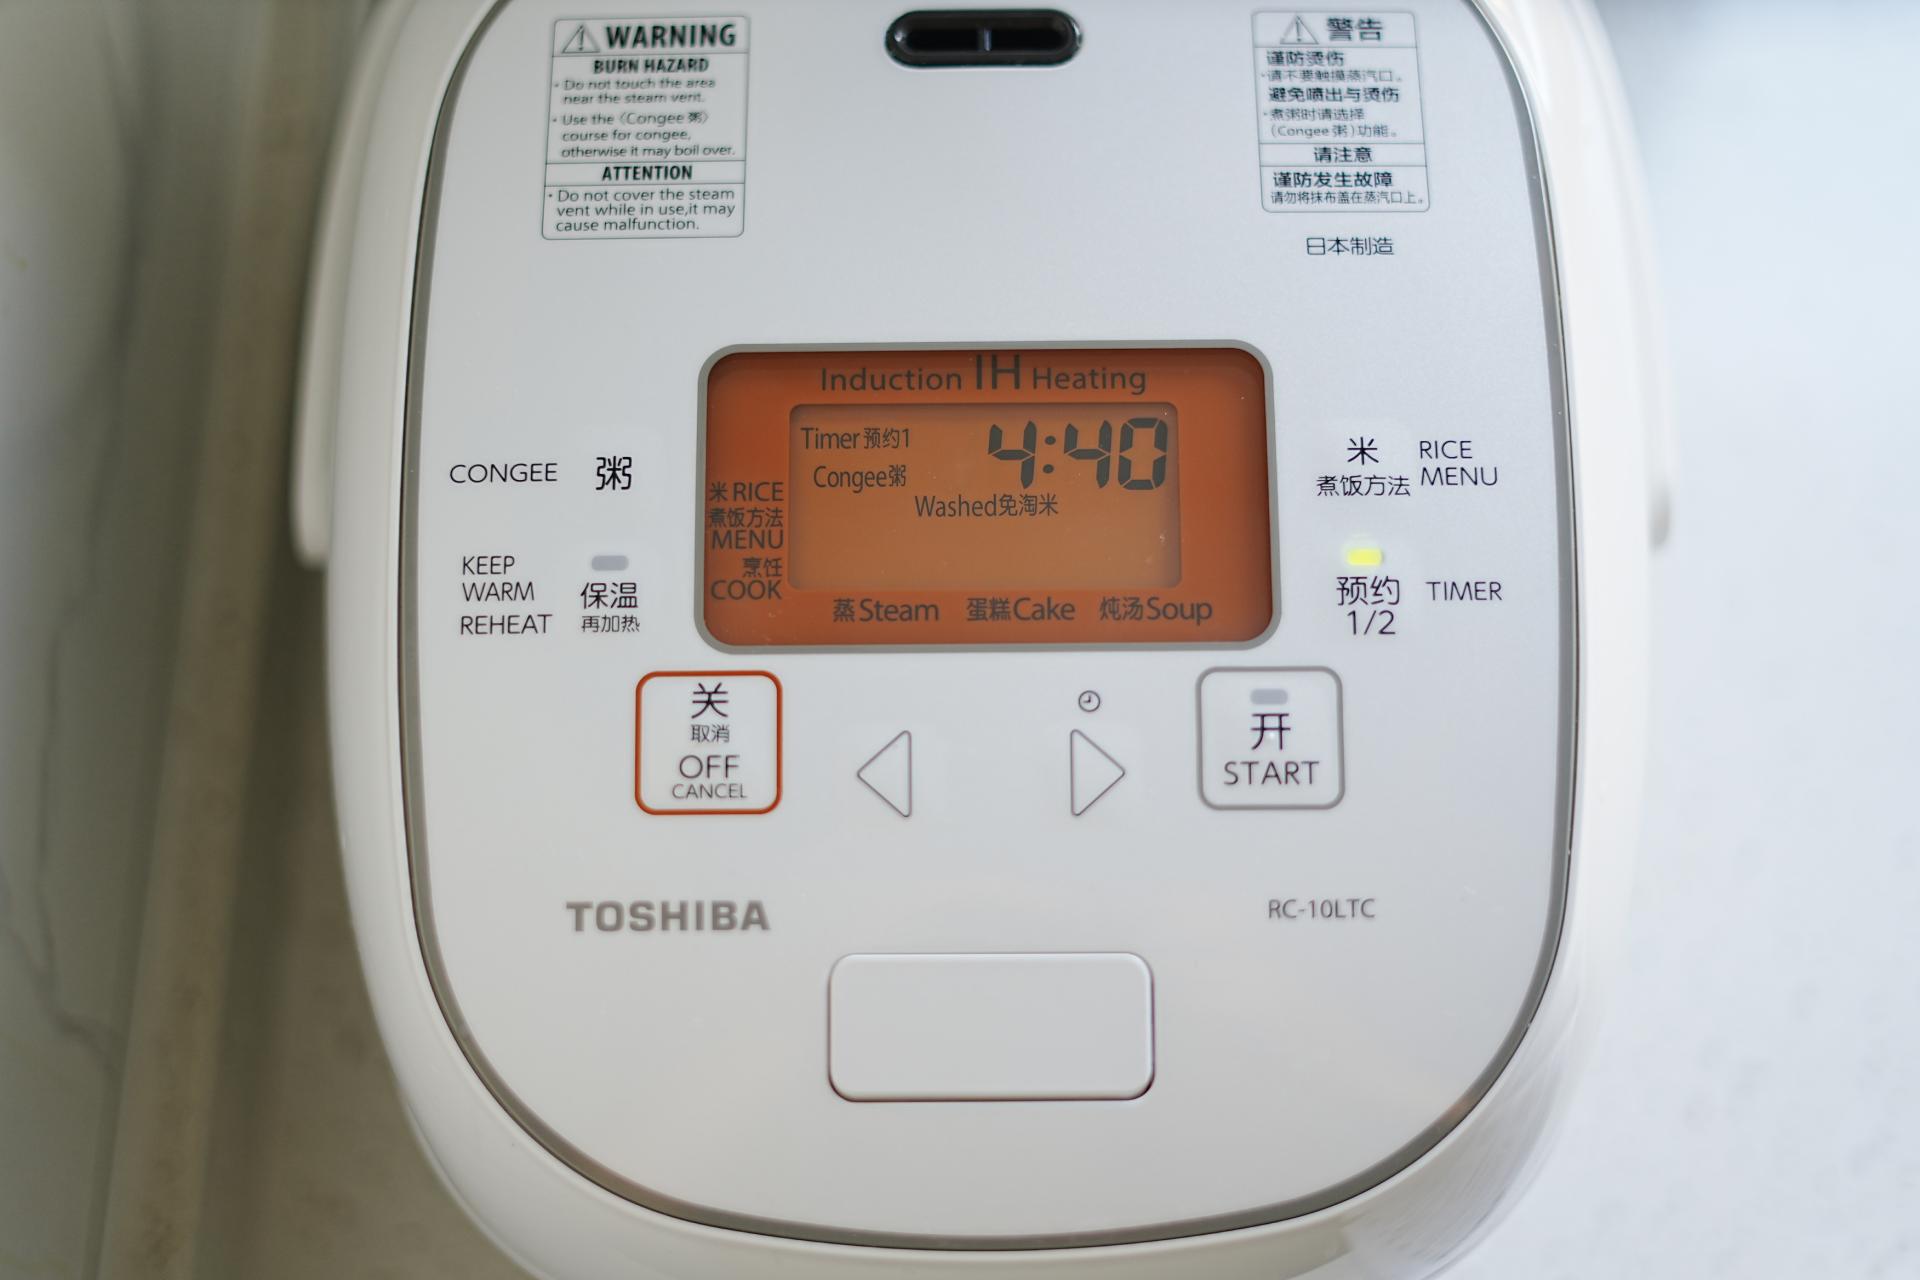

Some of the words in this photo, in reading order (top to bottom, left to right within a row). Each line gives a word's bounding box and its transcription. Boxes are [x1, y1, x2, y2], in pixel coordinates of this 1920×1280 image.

[605, 24, 736, 48] WARNING
[1327, 16, 1383, 41] 警告
[594, 59, 639, 74] BURN
[644, 58, 709, 73] HAZARD
[1267, 51, 1344, 66] 谨防烫伤
[564, 79, 584, 90] Do
[588, 79, 611, 90] not
[615, 78, 656, 89] touch
[660, 78, 683, 88] the
[686, 79, 716, 88] area
[563, 94, 593, 105] near
[598, 93, 620, 104] the
[624, 94, 667, 104] steam
[670, 93, 706, 103] vent.
[1268, 87, 1400, 102] 避免喷出与烫伤
[562, 114, 587, 126] Use
[592, 113, 614, 125] the
[562, 131, 608, 142] course
[612, 129, 632, 141] for
[635, 131, 691, 144] congee,
[561, 146, 627, 158] otherwise
[631, 146, 639, 157] it
[642, 147, 671, 159] may
[674, 144, 700, 156] boil
[702, 146, 735, 156] over.
[1313, 147, 1372, 163] 请注意
[601, 165, 692, 181] ATTENTION
[1273, 171, 1393, 188] 谨防发生故障
[558, 189, 579, 202] Do
[583, 190, 608, 201] not
[613, 190, 654, 201] cover
[660, 188, 685, 200] the
[689, 189, 735, 200] steam
[557, 205, 589, 216] vent
[595, 203, 635, 216] while
[640, 203, 653, 215] in
[703, 204, 736, 218] may
[556, 221, 599, 232] cause
[603, 218, 700, 231] malfunction.
[1306, 237, 1395, 256] 日本制造
[821, 367, 962, 391] Induction
[975, 354, 1021, 390] IH
[1032, 367, 1147, 395] Heating
[988, 417, 1168, 490] 4:40
[1347, 437, 1379, 465] 米
[1419, 440, 1473, 460] RICE
[449, 462, 558, 483] CONGEE
[595, 455, 632, 491] 粥
[1420, 467, 1498, 486] MENU
[1316, 474, 1411, 496] 煮饭方法
[709, 507, 784, 528] 煮饭方法
[712, 530, 784, 550] MENU
[462, 555, 515, 575] KEEP
[742, 557, 783, 578] 烹饪
[461, 581, 535, 602] WARM
[580, 582, 638, 609] 保温
[711, 580, 782, 600] COOK
[1336, 576, 1400, 606] 预约
[1426, 581, 1503, 601] TIMER
[460, 614, 553, 635] REHEAT
[581, 614, 640, 633] 再加热
[1347, 610, 1396, 635] 1/2
[691, 682, 729, 719] 关
[690, 723, 730, 743] 取消
[1250, 712, 1291, 751] 开
[679, 754, 740, 779] OFF
[1223, 760, 1320, 786] START
[671, 783, 747, 800] CANCEL
[566, 900, 771, 932] TOSHIBA
[1267, 898, 1376, 919] RC-10LTC
